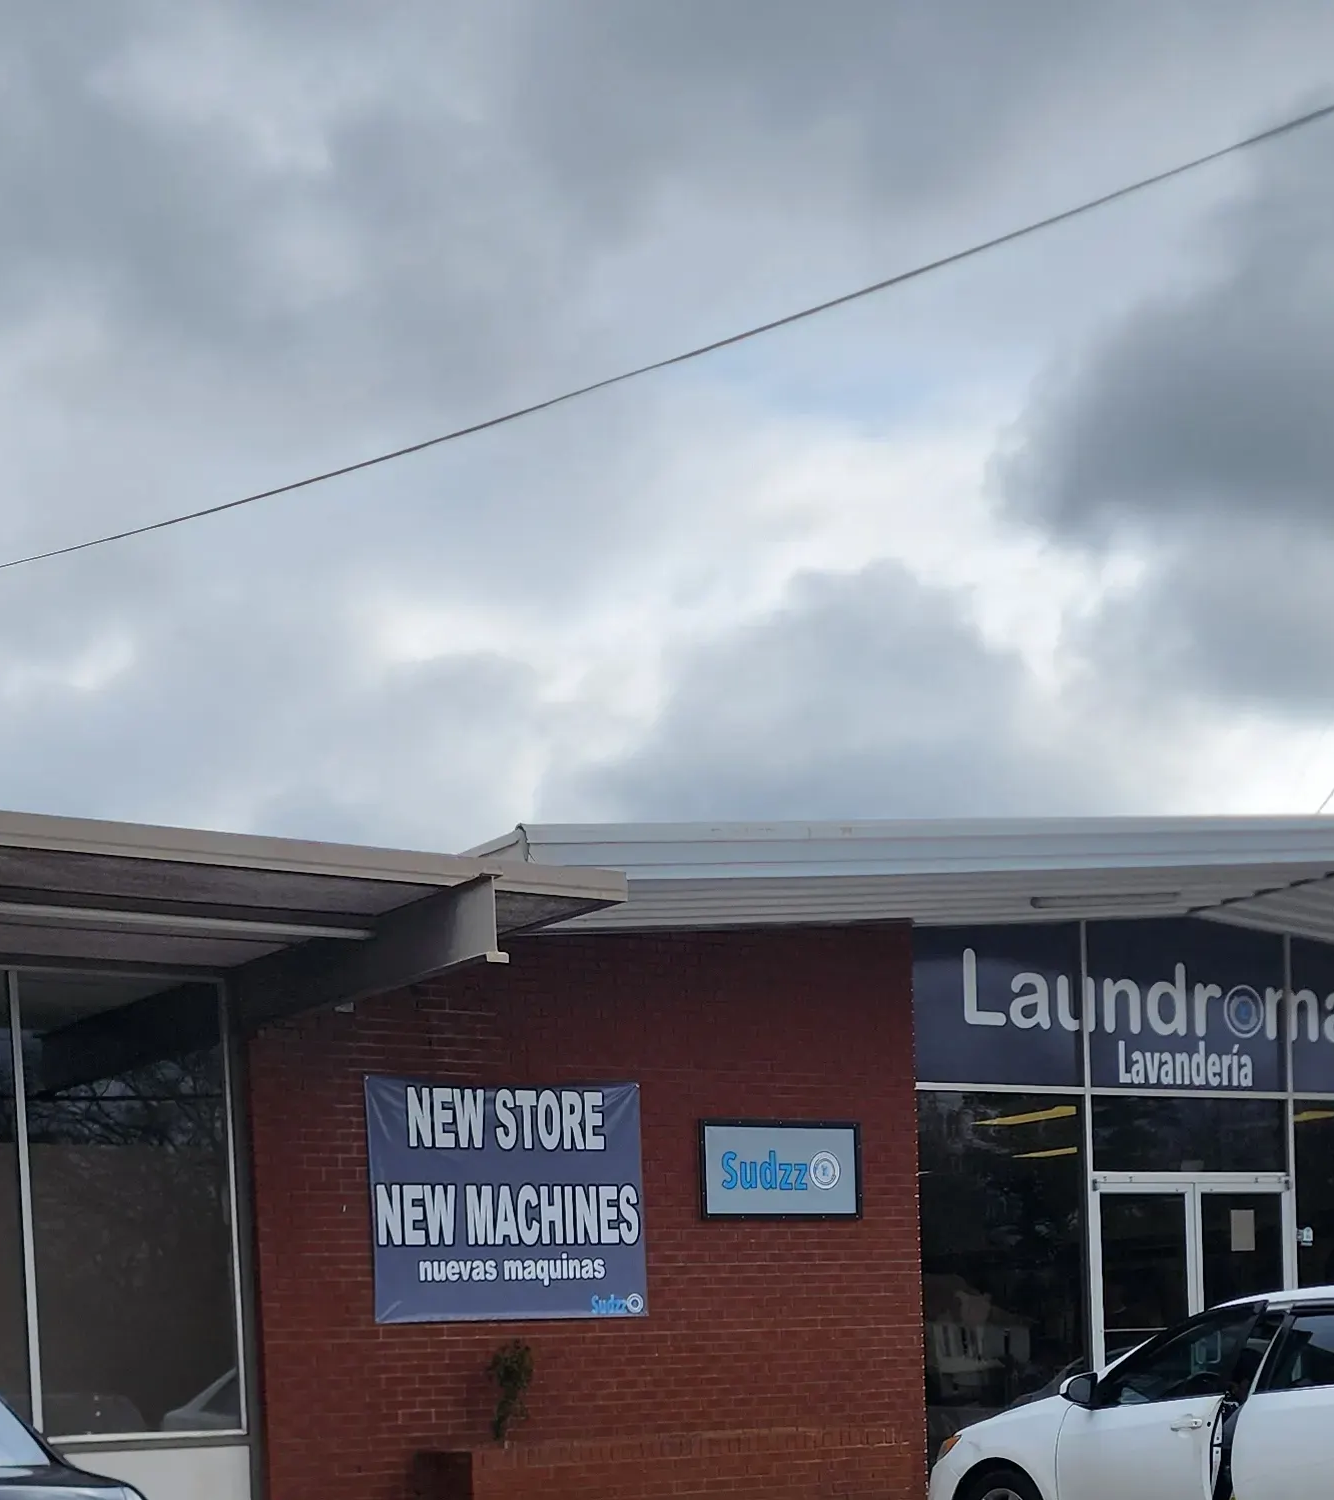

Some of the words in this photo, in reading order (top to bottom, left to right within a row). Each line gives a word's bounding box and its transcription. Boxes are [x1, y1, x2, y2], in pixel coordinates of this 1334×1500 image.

[1119, 1040, 1253, 1087] Lavandería
[406, 1085, 485, 1150] NEW
[495, 1088, 606, 1152] STORE
[375, 1183, 455, 1246] NEW
[466, 1183, 640, 1246] MACHINES
[419, 1258, 497, 1283] nuevas
[504, 1253, 606, 1287] maquinas
